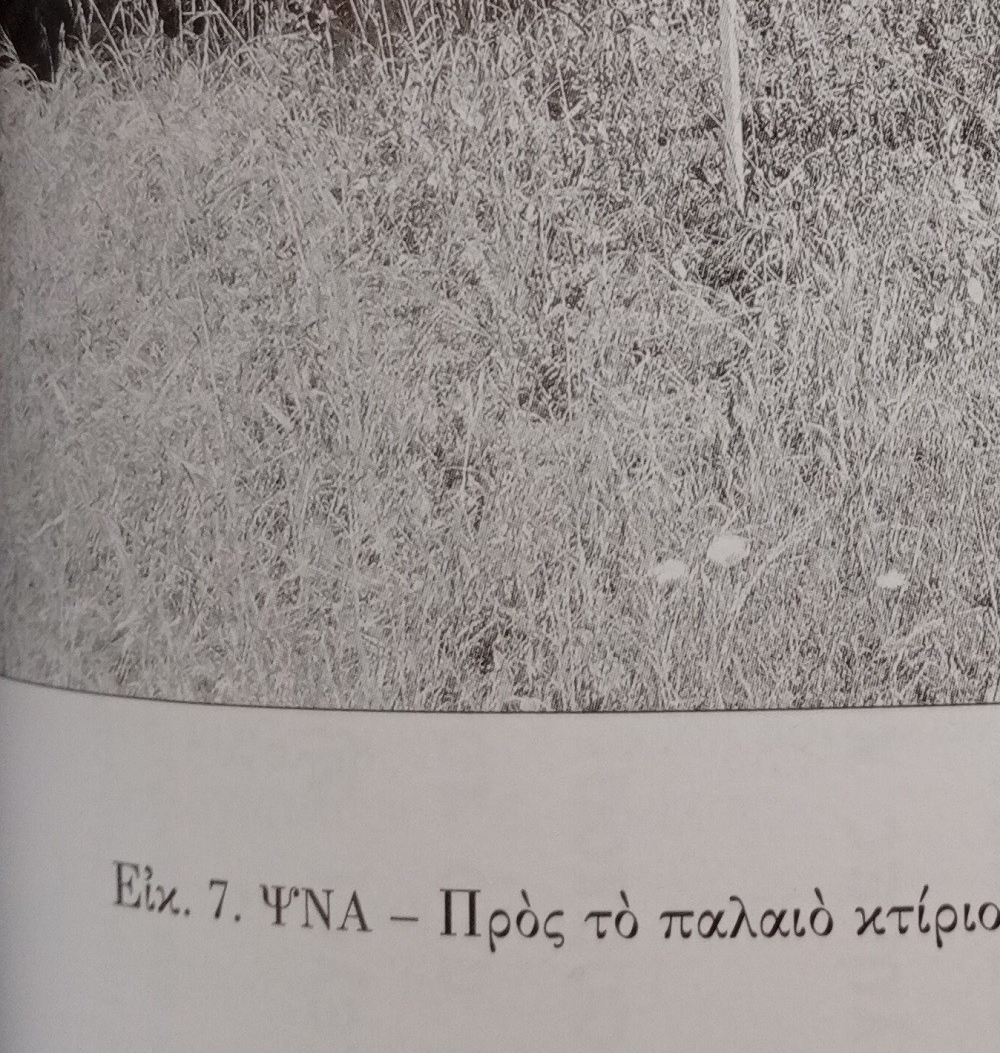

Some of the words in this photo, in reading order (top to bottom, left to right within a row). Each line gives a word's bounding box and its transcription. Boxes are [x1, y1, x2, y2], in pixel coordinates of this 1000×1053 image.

[208, 878, 242, 923] 7.
[439, 887, 566, 954] Πρὸς
[583, 889, 640, 941] τὸ
[658, 886, 835, 940] παλαιὸ
